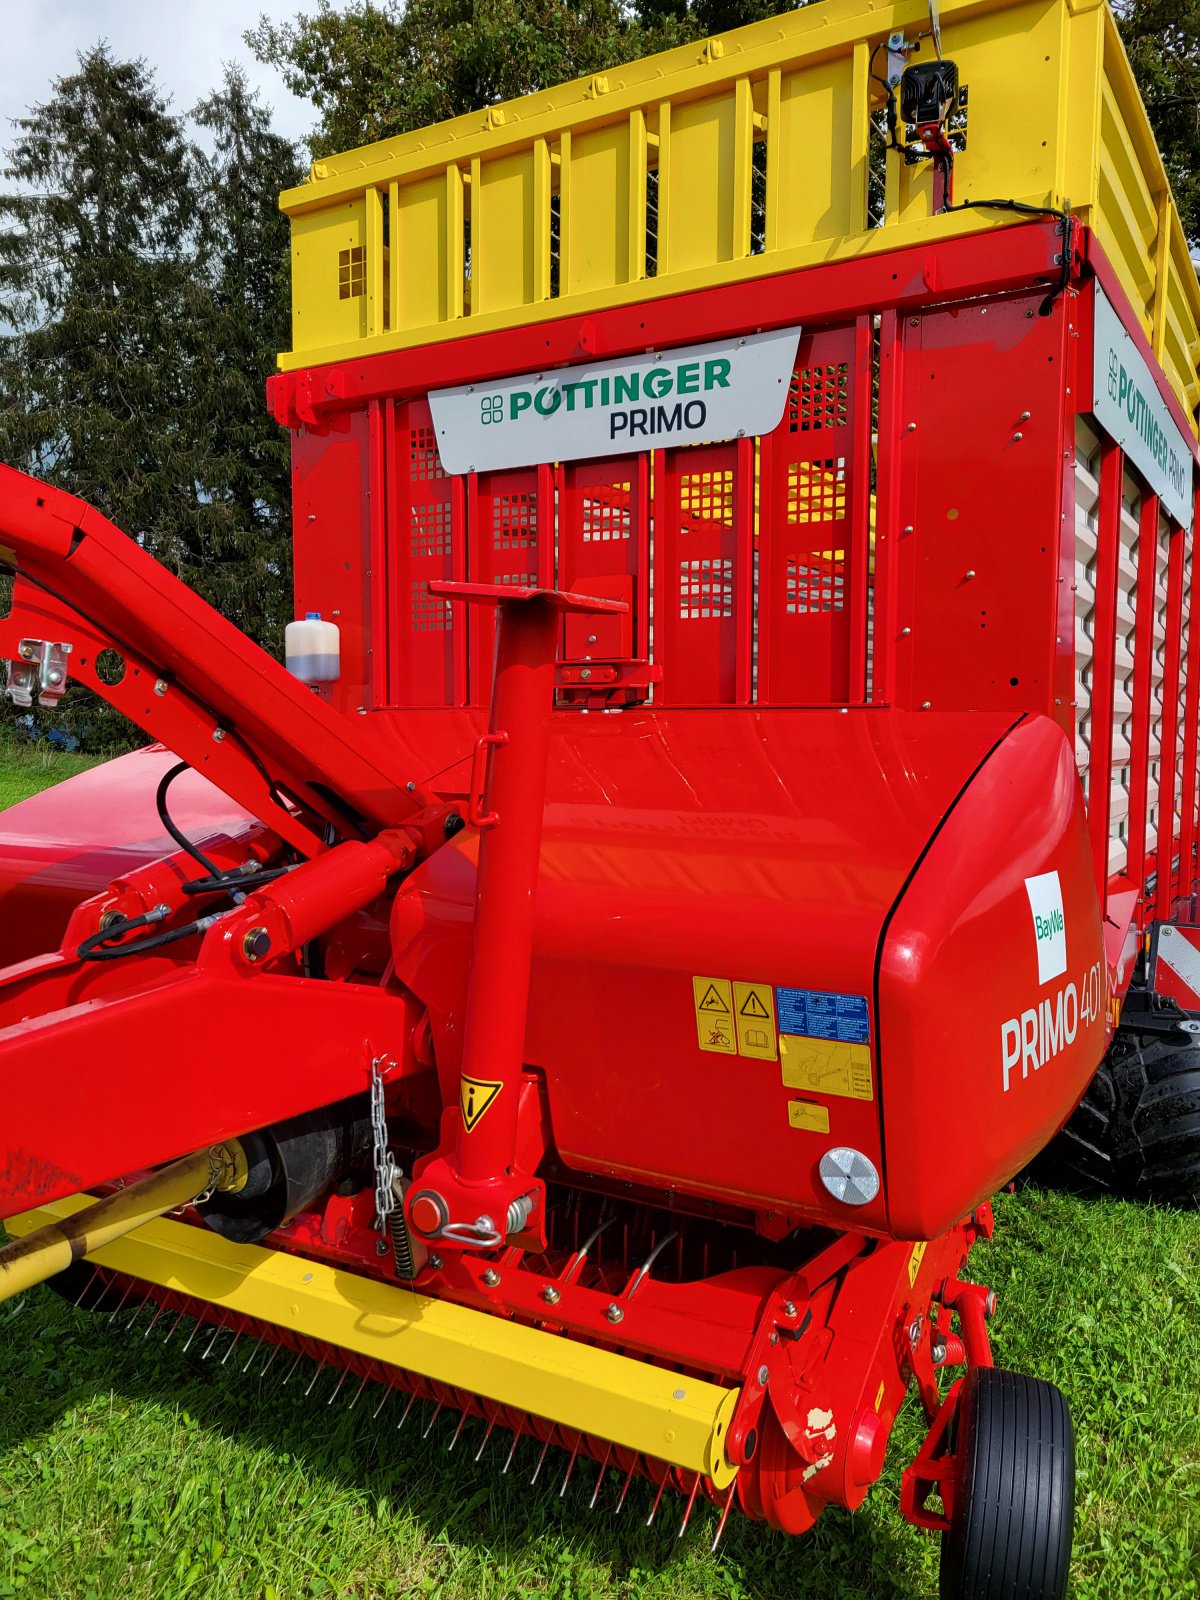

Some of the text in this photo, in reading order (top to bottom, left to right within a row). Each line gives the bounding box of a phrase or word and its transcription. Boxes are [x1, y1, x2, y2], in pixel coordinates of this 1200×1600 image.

[610, 399, 707, 440] PRIMO
[1168, 447, 1185, 501] PRIMO
[1035, 908, 1064, 941] BayWa
[1001, 961, 1101, 1093] PRIMO 401
